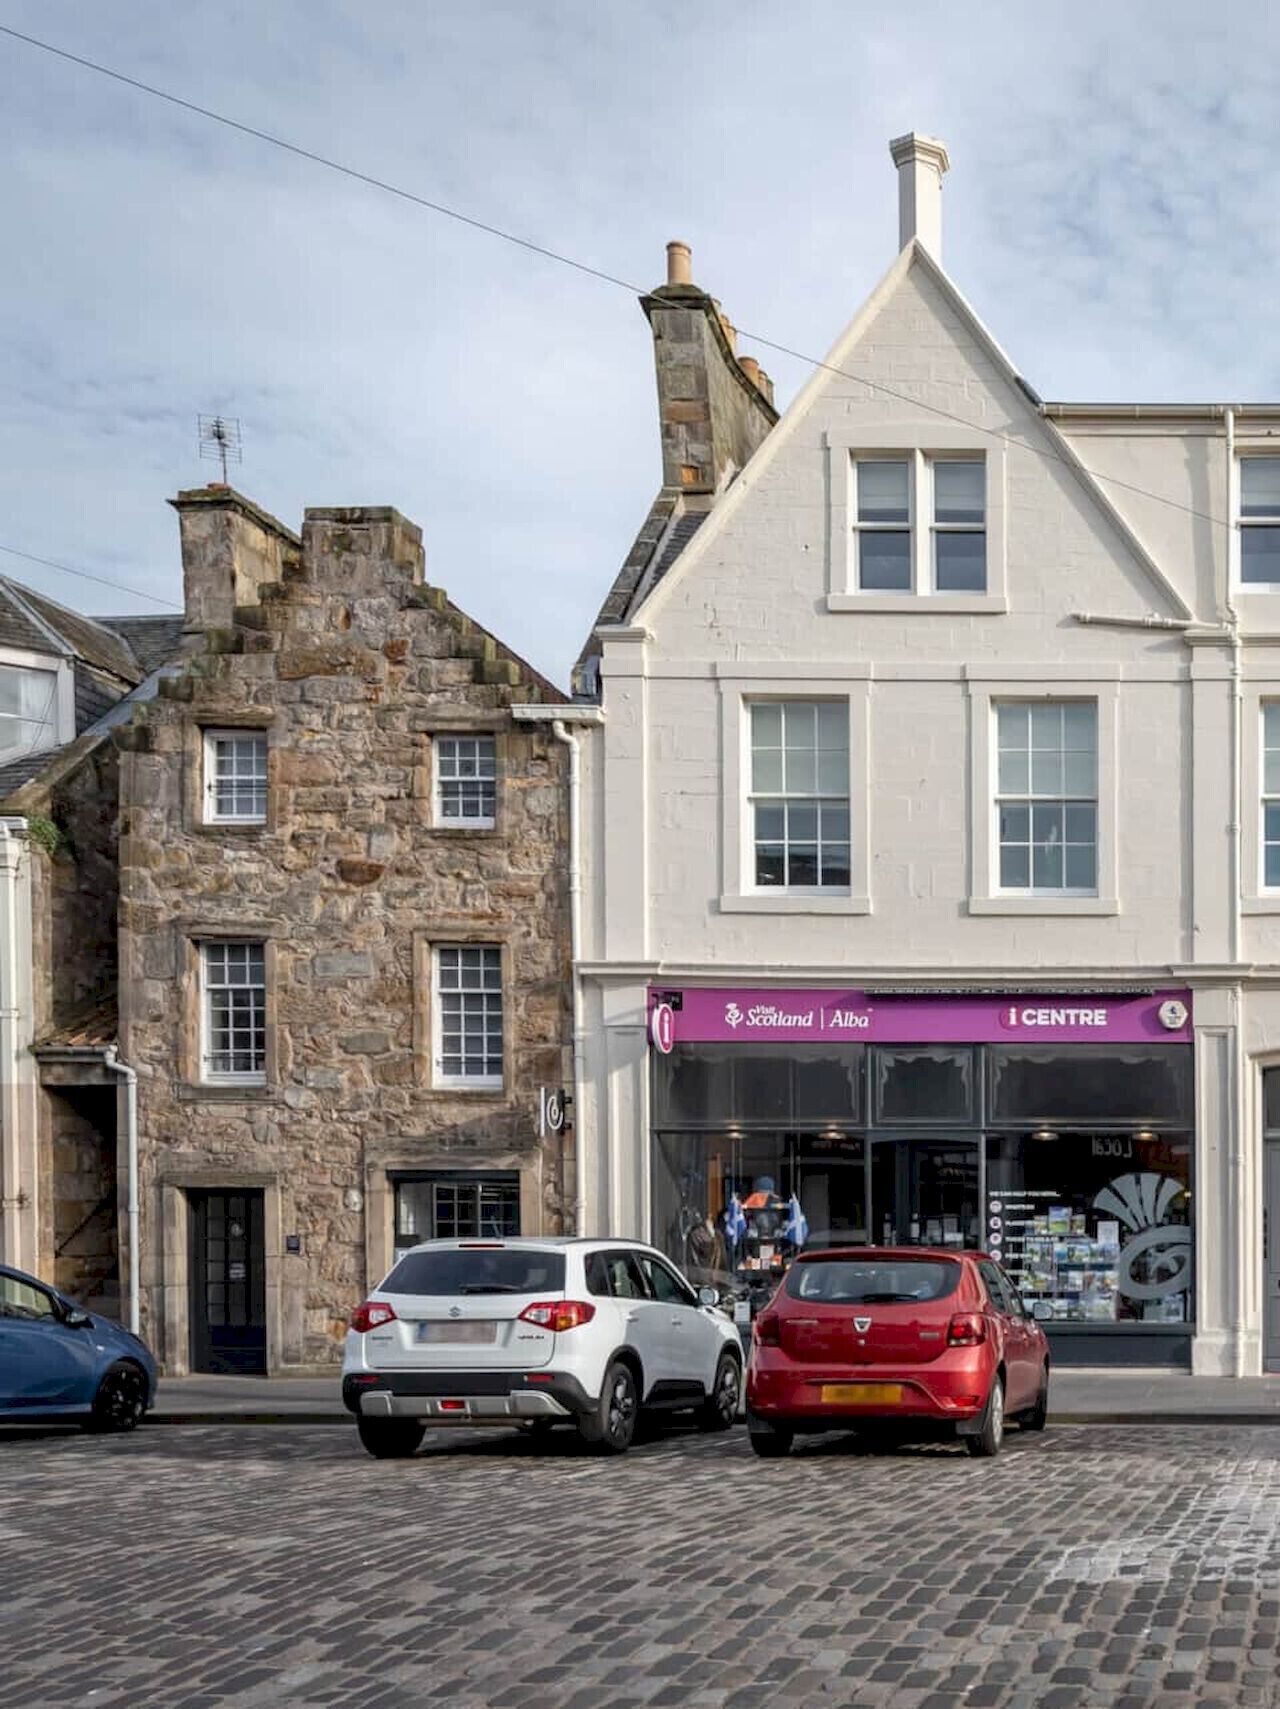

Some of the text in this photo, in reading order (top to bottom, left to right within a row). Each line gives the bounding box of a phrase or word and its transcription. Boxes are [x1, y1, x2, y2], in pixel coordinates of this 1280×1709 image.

[746, 1008, 813, 1027] Scotland
[755, 1004, 776, 1015] Visit
[829, 1009, 869, 1028] Alba
[1008, 1007, 1108, 1026] i CENTRE
